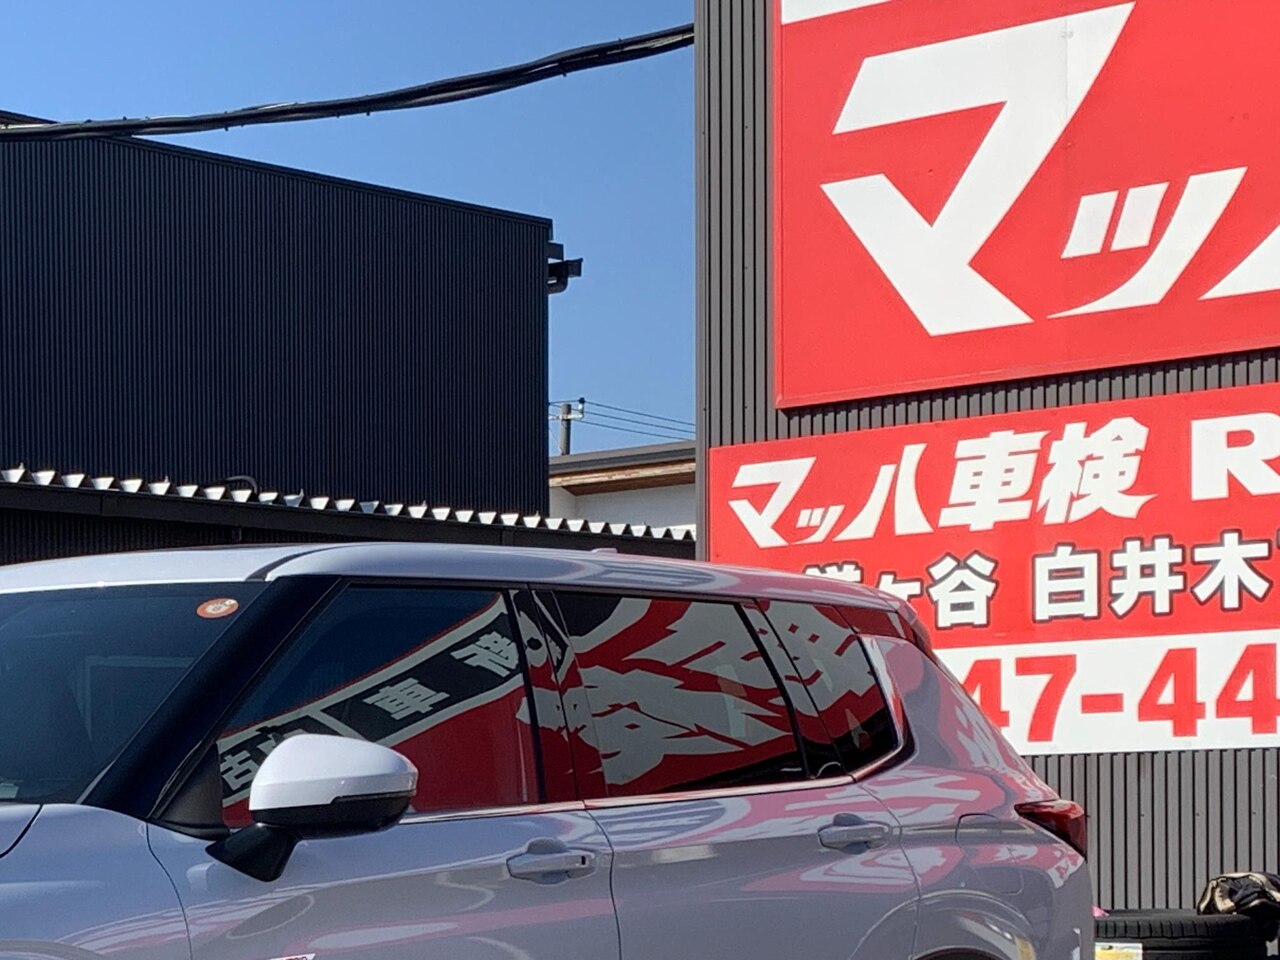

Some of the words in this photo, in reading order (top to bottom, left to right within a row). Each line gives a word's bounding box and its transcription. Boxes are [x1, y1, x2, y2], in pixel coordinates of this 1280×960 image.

[820, 1, 1280, 337] マッ
[1032, 529, 1280, 624] 白井木
